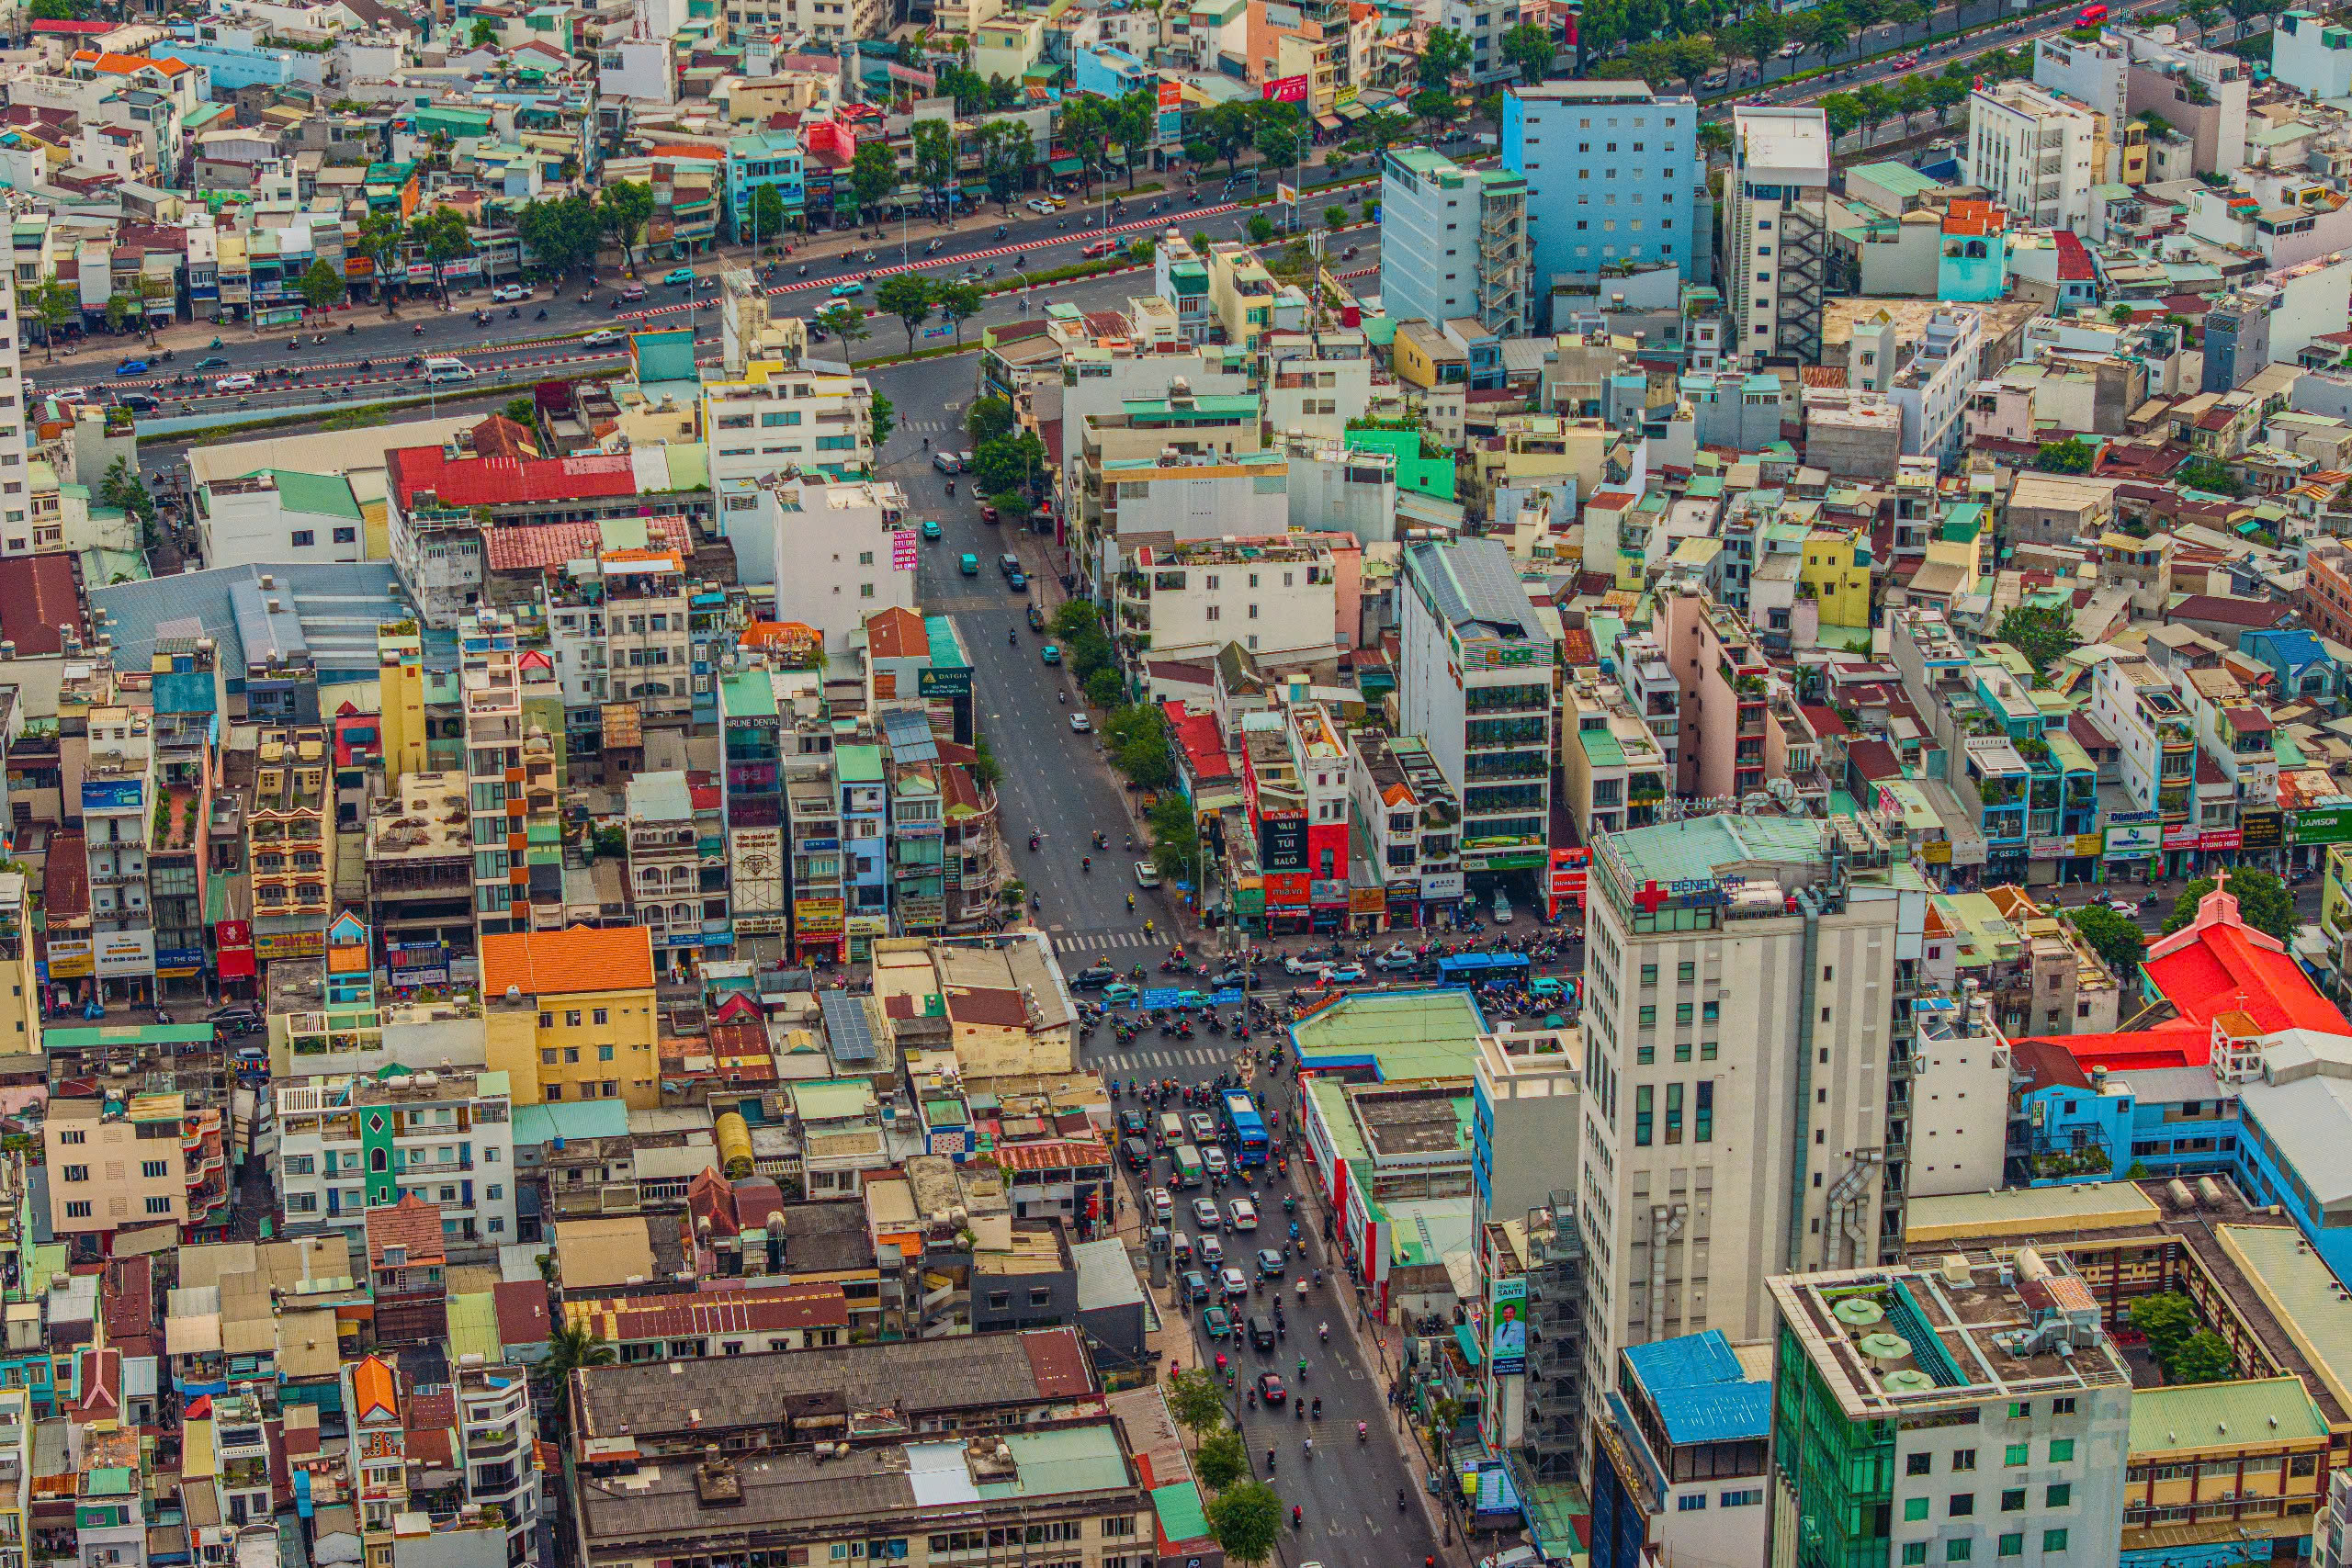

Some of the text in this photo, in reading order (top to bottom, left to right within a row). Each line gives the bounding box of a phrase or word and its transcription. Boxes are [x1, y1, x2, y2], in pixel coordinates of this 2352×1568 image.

[726, 717, 780, 728] AIRLINE DENTAL
[1276, 821, 1296, 830] VALI
[2300, 817, 2338, 828] LAMSON
[1277, 837, 1295, 848] TÚI
[2223, 839, 2239, 847] HIẾU
[1273, 854, 1297, 865] BALÔ
[1999, 850, 2019, 858] GS25
[1670, 874, 1746, 892] BỆNH VIỆN
[1498, 1288, 1523, 1296] SANTE
